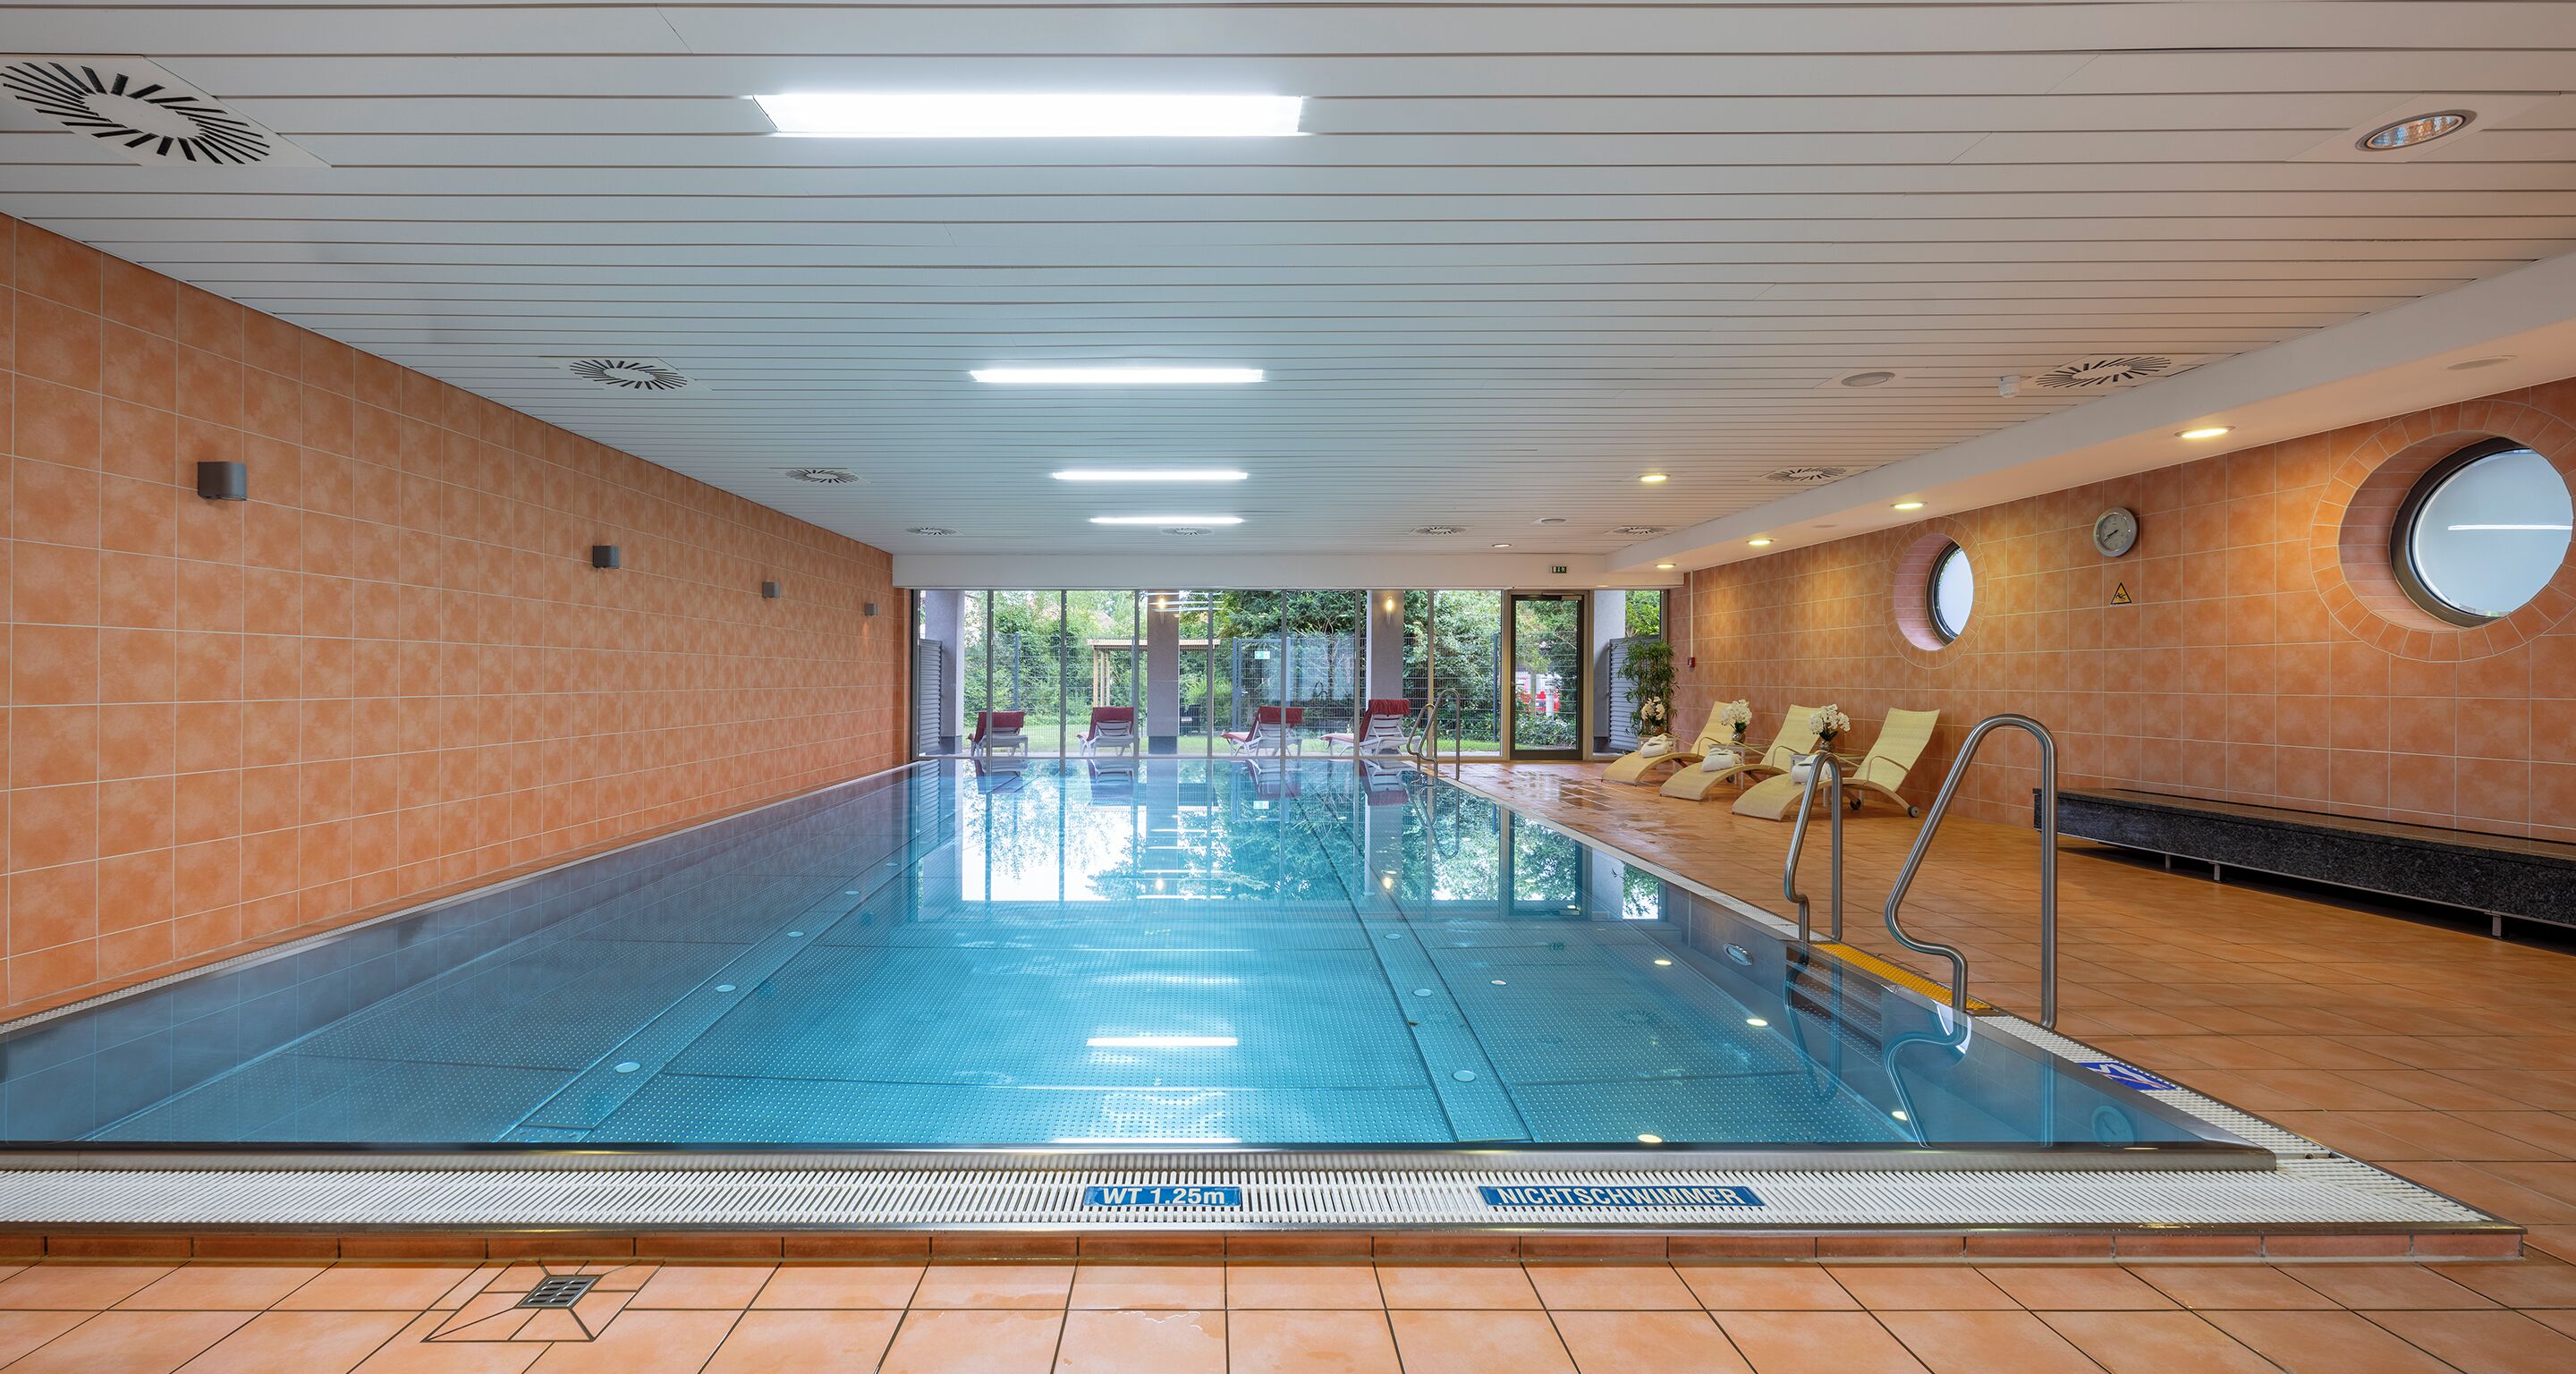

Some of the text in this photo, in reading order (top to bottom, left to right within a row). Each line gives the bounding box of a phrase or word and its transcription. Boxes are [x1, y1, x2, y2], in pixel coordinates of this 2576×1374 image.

[1103, 1188, 1225, 1205] WT 1.25m
[1496, 1187, 1746, 1205] NICHTSCHWIMMER
